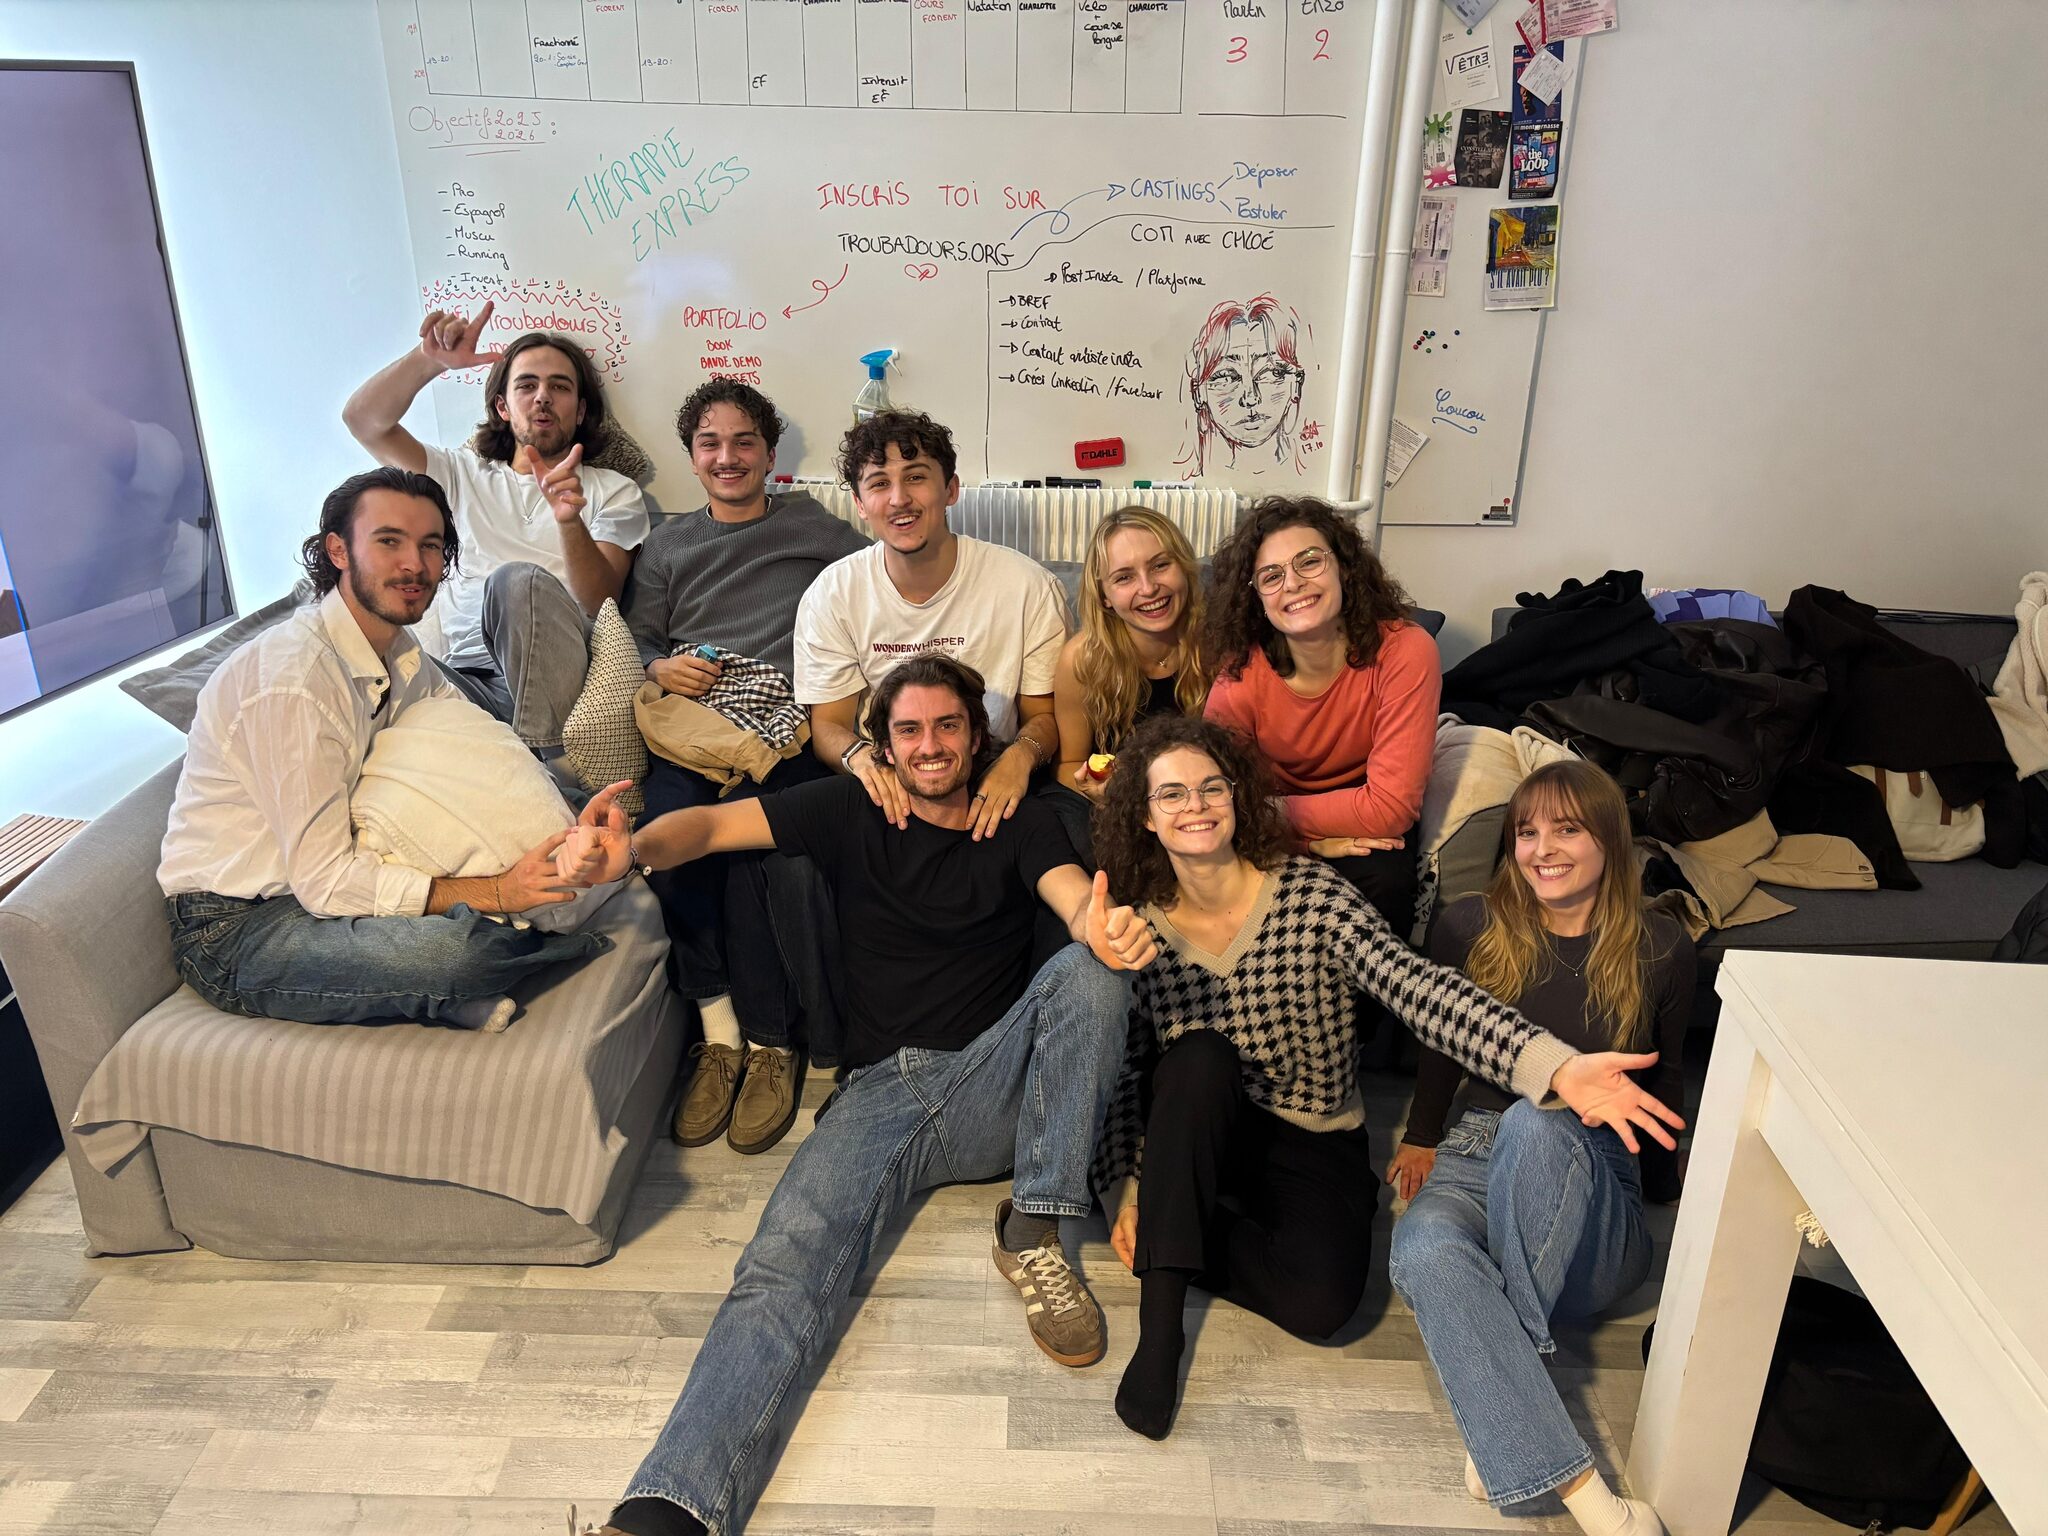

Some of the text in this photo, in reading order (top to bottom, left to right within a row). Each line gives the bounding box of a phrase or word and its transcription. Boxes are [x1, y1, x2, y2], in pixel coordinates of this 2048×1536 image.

[1226, 36, 1248, 63] 3
[1313, 29, 1329, 60] 2
[409, 106, 492, 143] Objectifs
[495, 109, 541, 126] 2025
[1521, 158, 1549, 172] LOOP
[1528, 149, 1542, 160] the
[1233, 162, 1298, 188] Déposer
[452, 182, 475, 197] Pro
[1003, 186, 1046, 210] SUR
[454, 203, 505, 225] Espagnol
[632, 156, 750, 262] EXPRESS
[1235, 197, 1288, 220] Postuler
[454, 225, 495, 241] Muscu
[458, 244, 509, 271] Running
[838, 233, 1014, 266] TROUBADOURS.ORG
[460, 272, 503, 285] Invest
[1490, 269, 1503, 289] S'IL
[1506, 268, 1526, 288] AVAIT
[1528, 267, 1543, 287] PLU
[1018, 295, 1052, 310] BREF
[706, 339, 733, 351] BOOK
[700, 356, 762, 369] BANDE DEMO
[1435, 388, 1486, 422] Coucou
[1090, 448, 1119, 460] DAHLE
[873, 637, 965, 653] WONDERWHISPER
